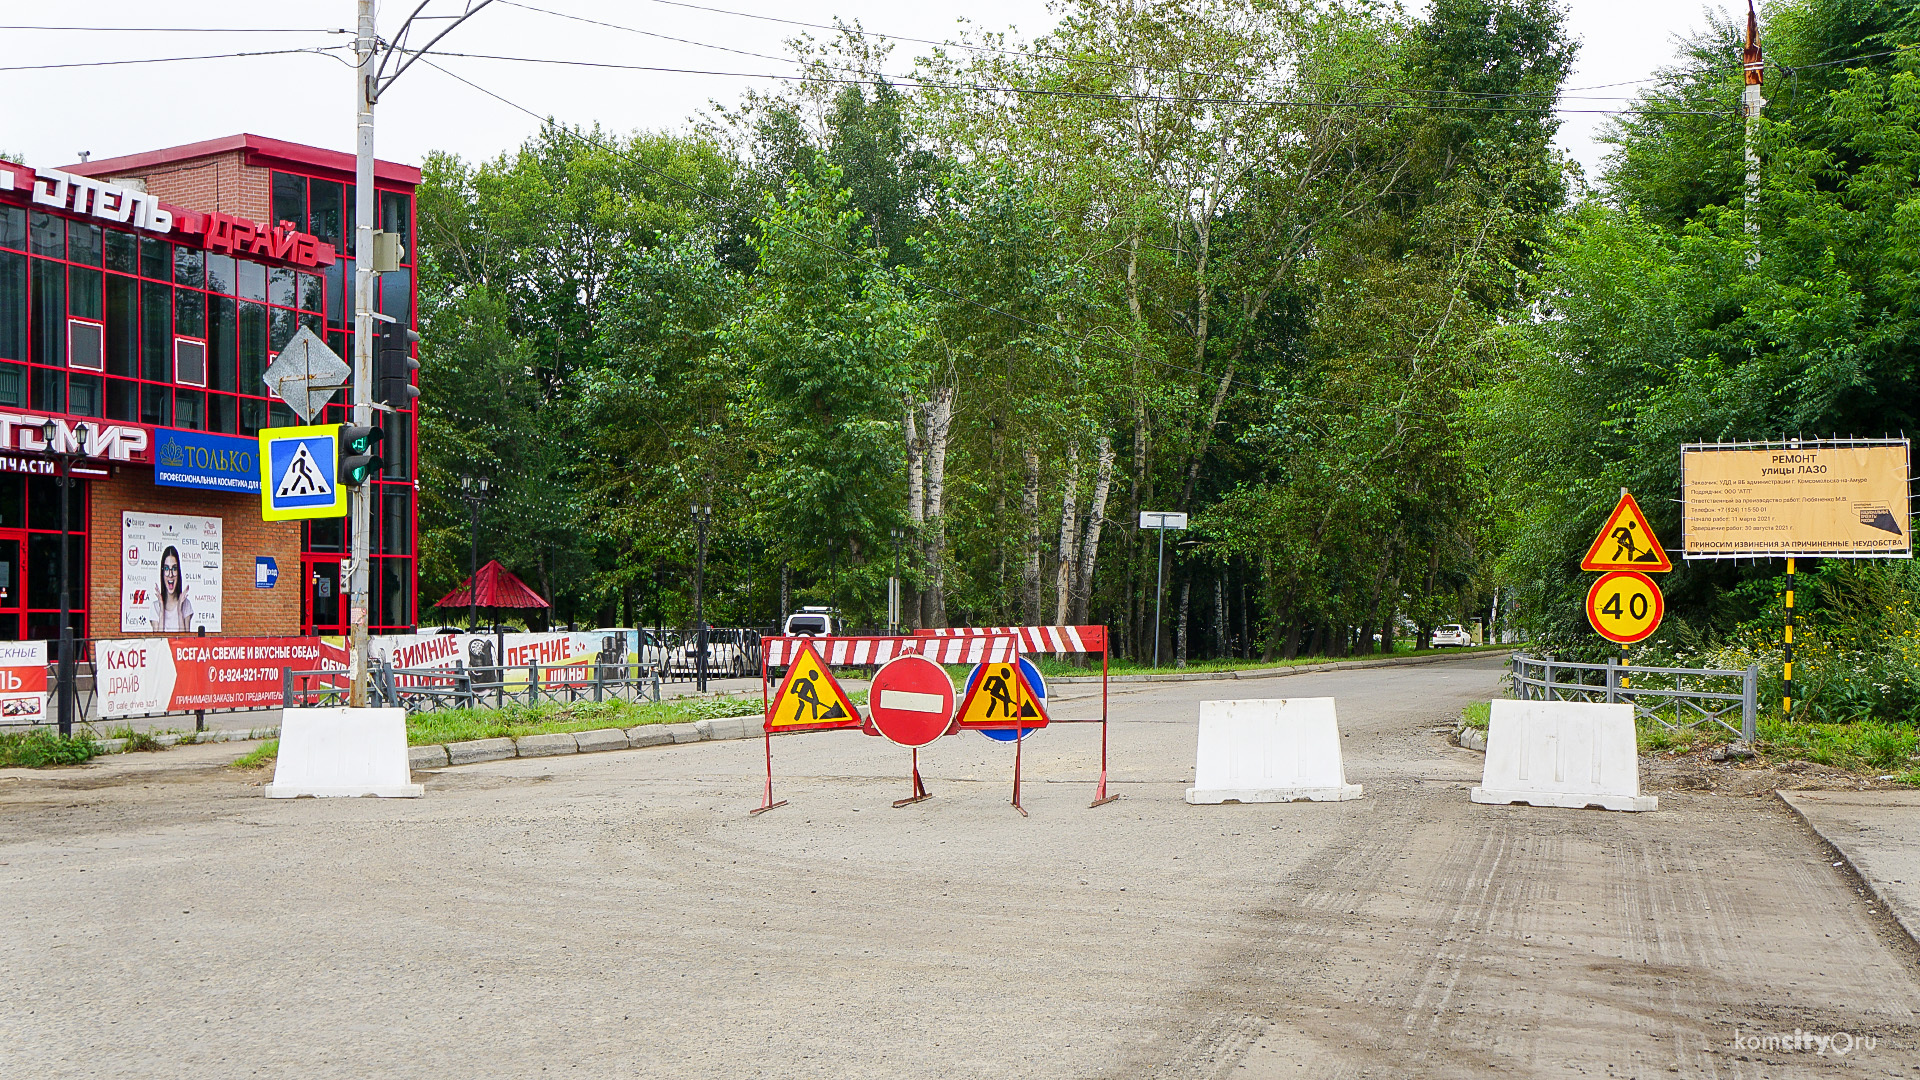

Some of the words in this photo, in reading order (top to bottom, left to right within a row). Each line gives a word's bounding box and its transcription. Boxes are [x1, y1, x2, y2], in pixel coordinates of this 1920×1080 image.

[203, 211, 319, 267] ДРАЙВ
[184, 446, 251, 473] ТОЛЬКО
[1772, 454, 1818, 464] РЕМОНТ
[1761, 467, 1795, 477] улицы
[1797, 464, 1828, 474] ЛАЗО
[159, 472, 217, 486] ПРОФЕССИОНАЛЬНАЯ
[217, 477, 248, 488] КОСМЕТИКА
[248, 481, 259, 490] ДЛЯ
[1852, 539, 1903, 547] НЕУДОБСТВА
[1601, 592, 1648, 620] 40
[107, 649, 147, 670] КАФЕ
[176, 647, 211, 663] ВСЕГДА
[211, 646, 246, 661] СВЕЖИЕ
[247, 646, 254, 660] И
[254, 645, 290, 660] ВКУСНЫЕ
[291, 645, 320, 661] ОБЕДЫ
[393, 634, 459, 669] ЗИМНИЕ
[507, 637, 571, 671] ЛЕТНИЕ
[218, 667, 279, 683] 8-924-921-7700
[107, 673, 140, 697] ДРАЙВ
[175, 694, 213, 705] ПРИНИМАЕМ
[213, 693, 235, 703] ЗАКАЗЫ
[235, 692, 245, 702] ПО
[245, 690, 284, 702] ПРЕДВАРИТЕЛЬ
